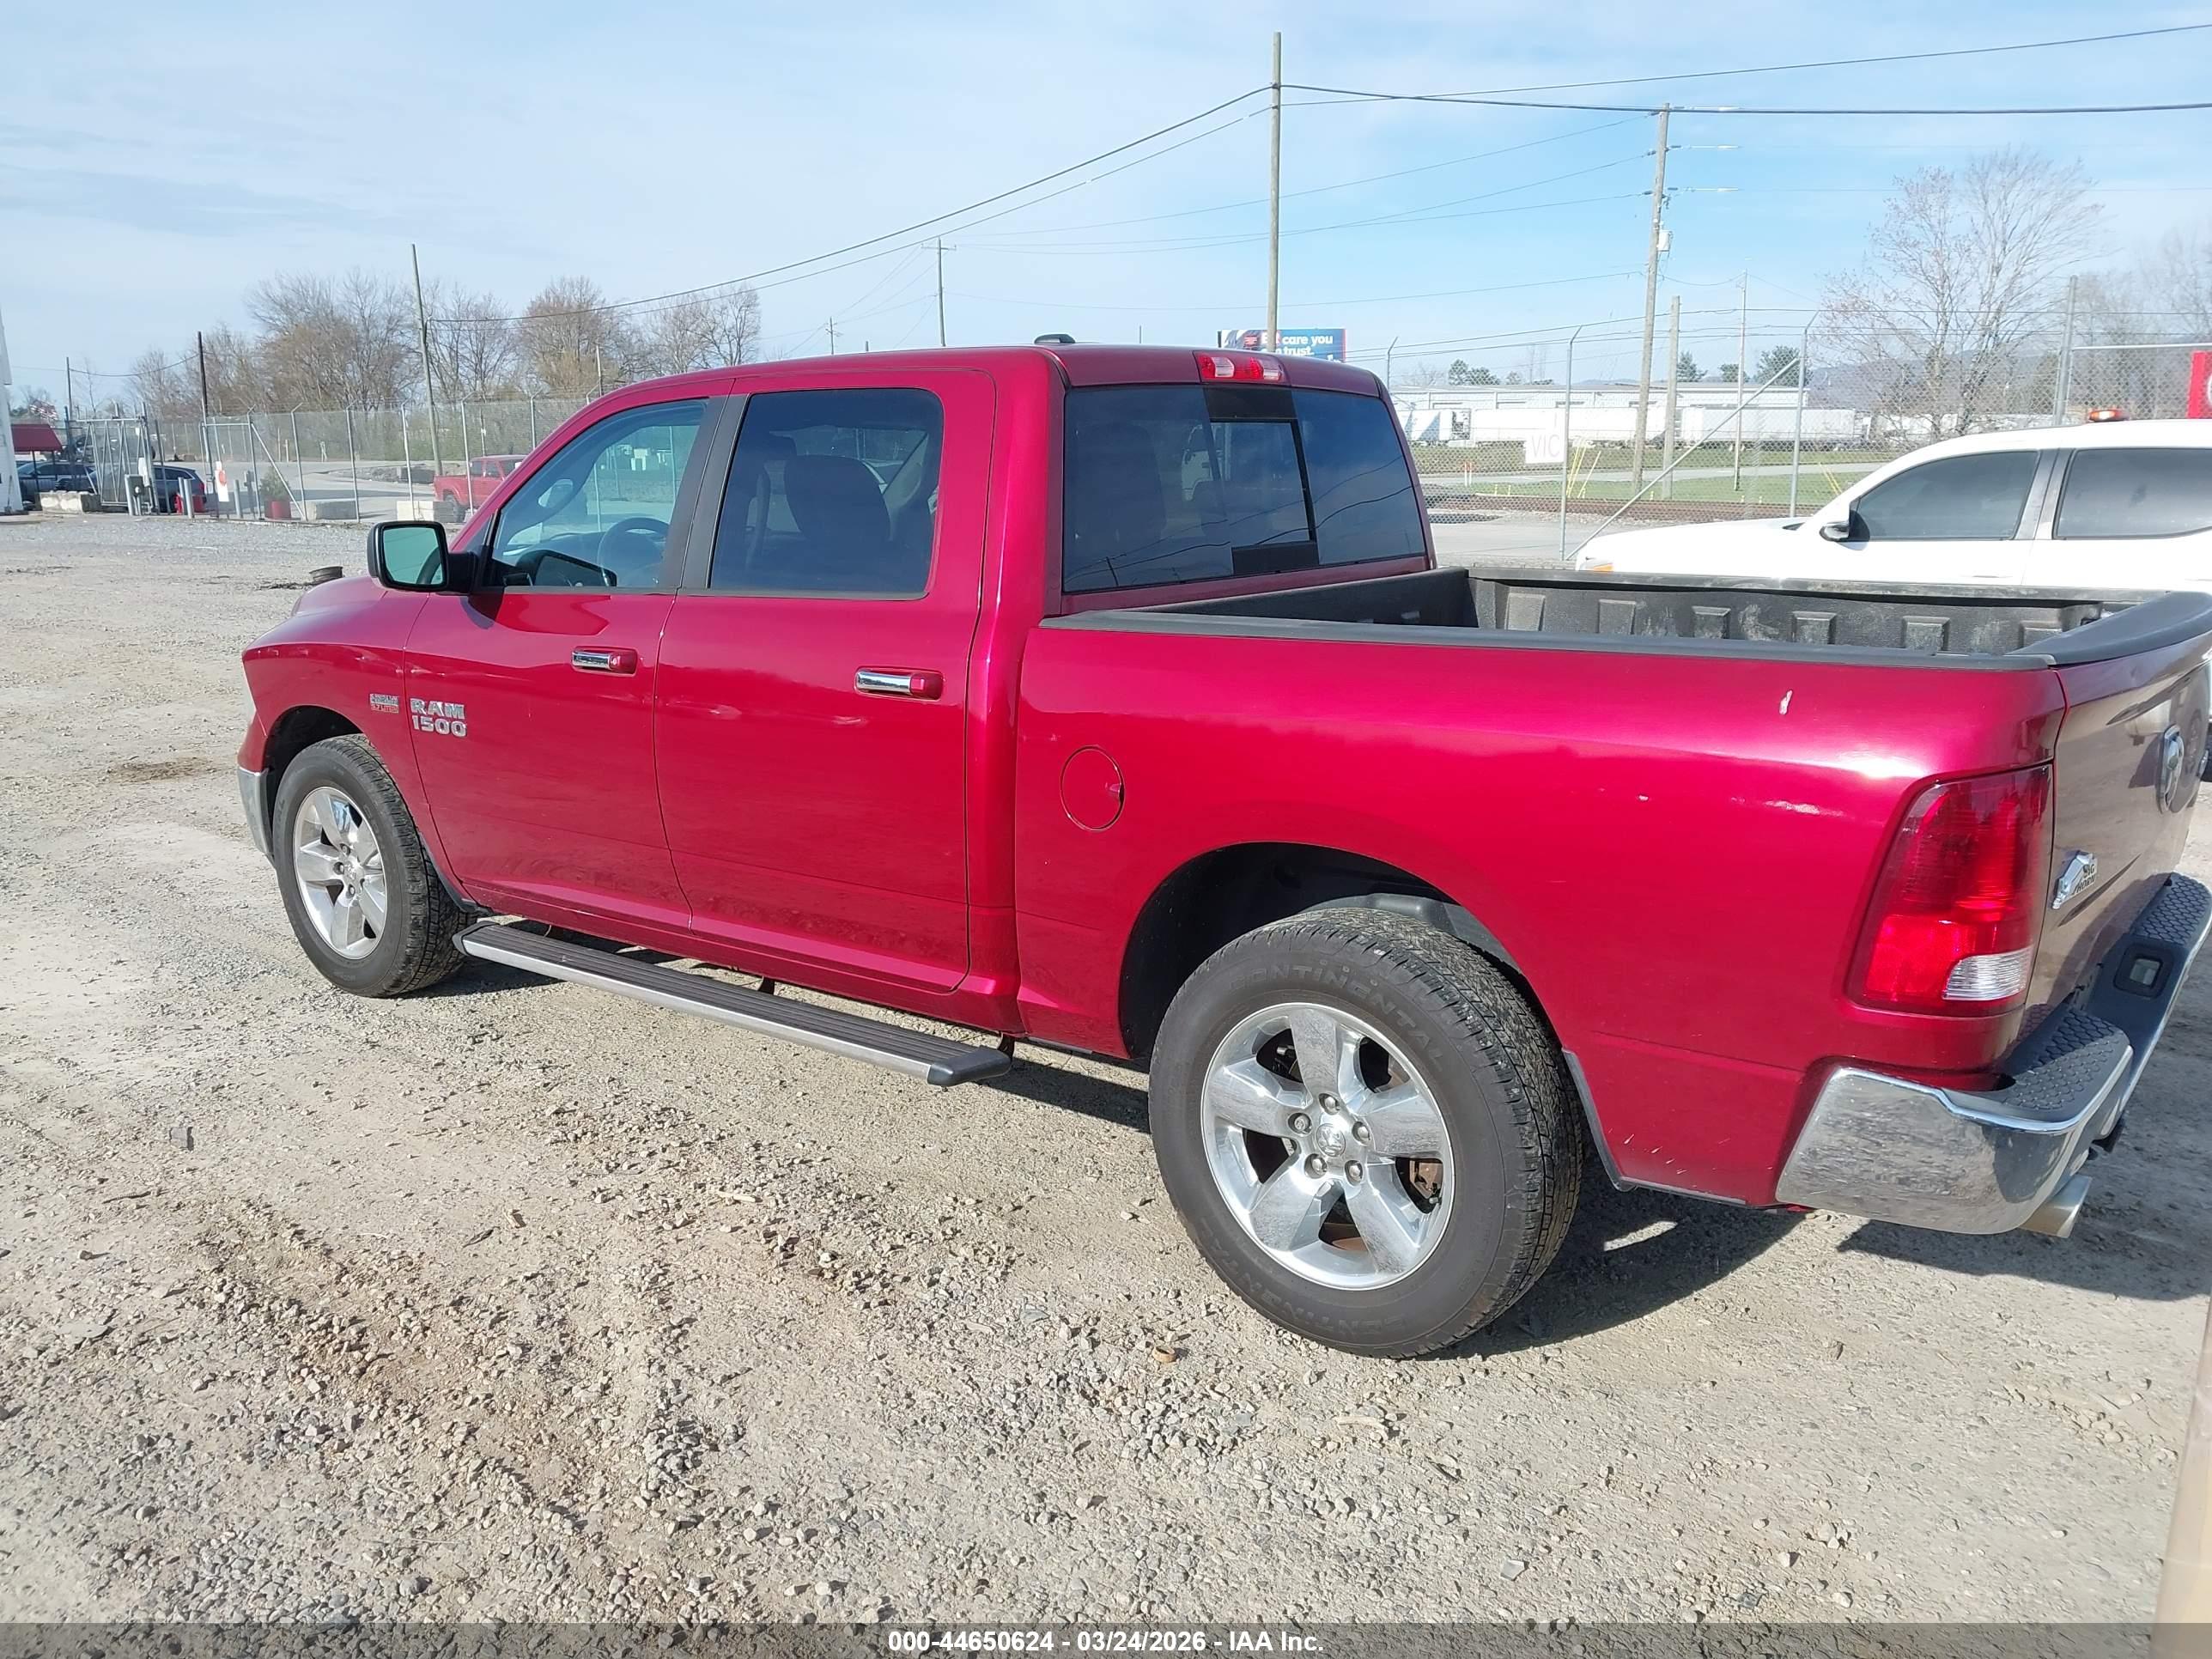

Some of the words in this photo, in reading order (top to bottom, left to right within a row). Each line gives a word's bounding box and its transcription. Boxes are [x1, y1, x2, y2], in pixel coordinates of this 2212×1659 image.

[1282, 336, 1309, 344] care
[1311, 336, 1334, 347] you
[410, 697, 465, 720] RAM
[412, 714, 467, 738] 1500
[2075, 874, 2096, 893] HORN
